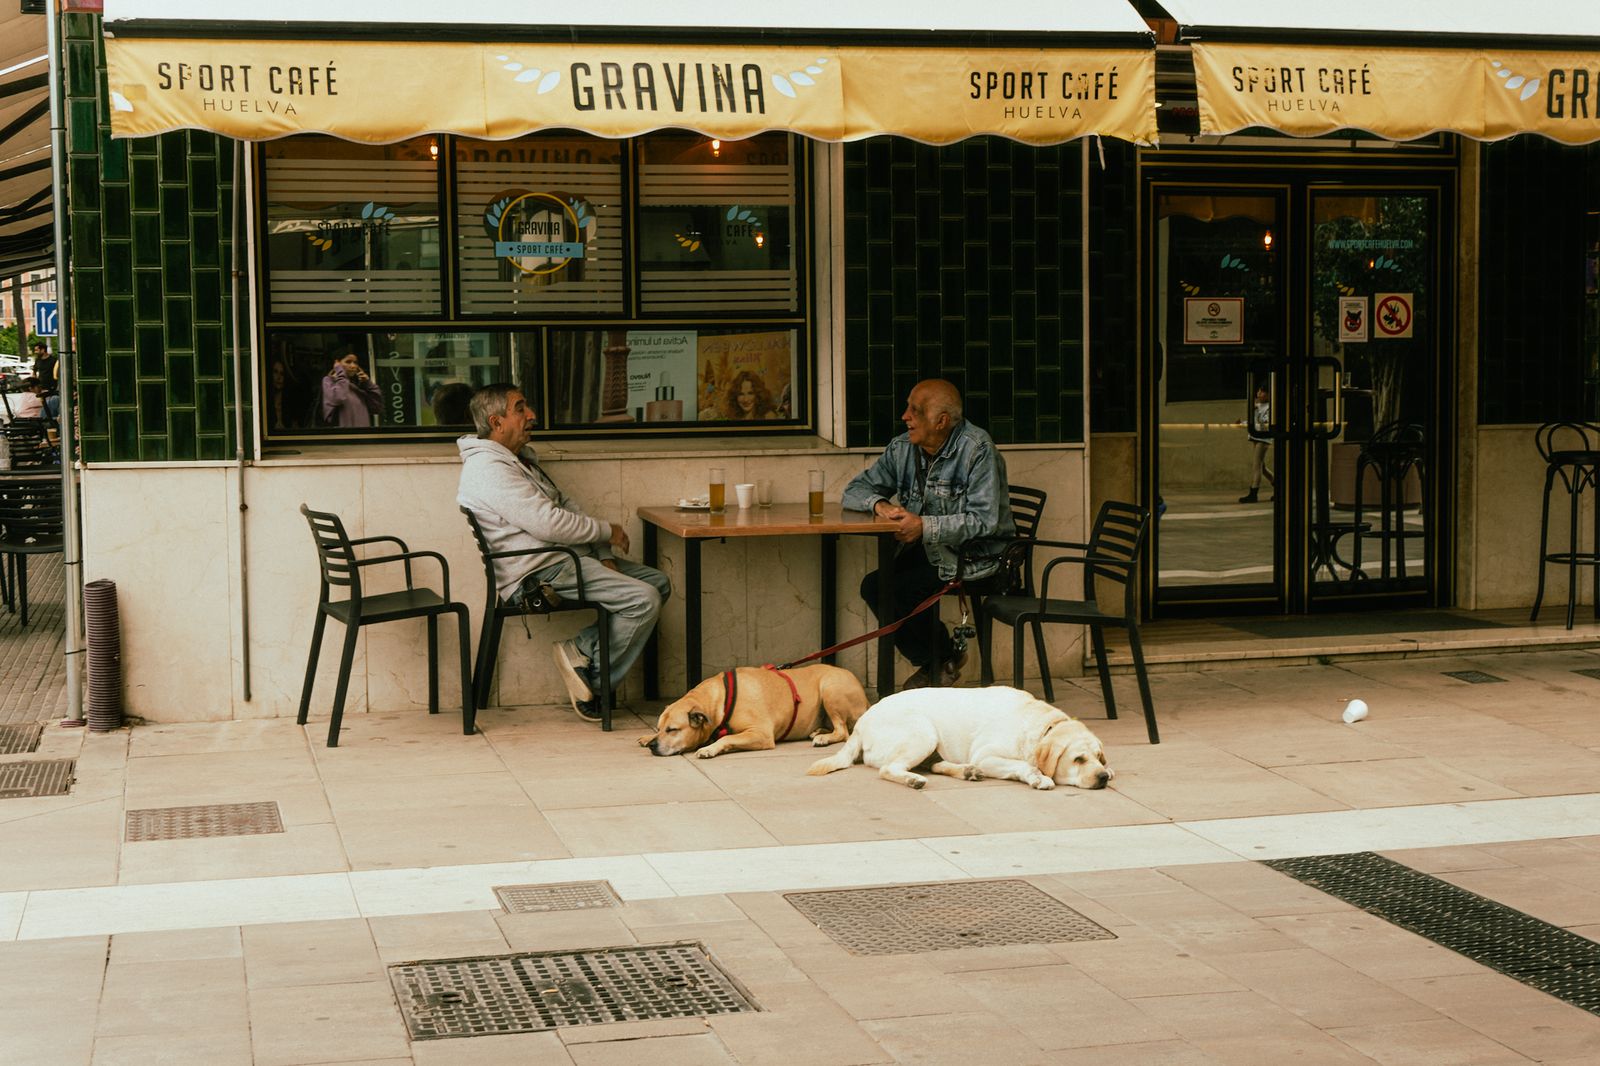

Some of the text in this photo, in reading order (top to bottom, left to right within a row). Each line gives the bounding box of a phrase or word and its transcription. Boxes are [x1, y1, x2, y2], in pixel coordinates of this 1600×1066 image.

[157, 60, 338, 96] SPORT CAFÉ
[570, 62, 766, 115] GRAVINA
[970, 71, 1048, 100] SPORT
[1232, 64, 1371, 95] SPORT CAFÉ
[1268, 99, 1340, 112] HUELVA
[1546, 69, 1600, 119] GR
[203, 98, 297, 116] HUELVA
[1004, 106, 1082, 119] HUELVA
[518, 221, 561, 236] GRAVINA
[516, 244, 542, 255] SPORT
